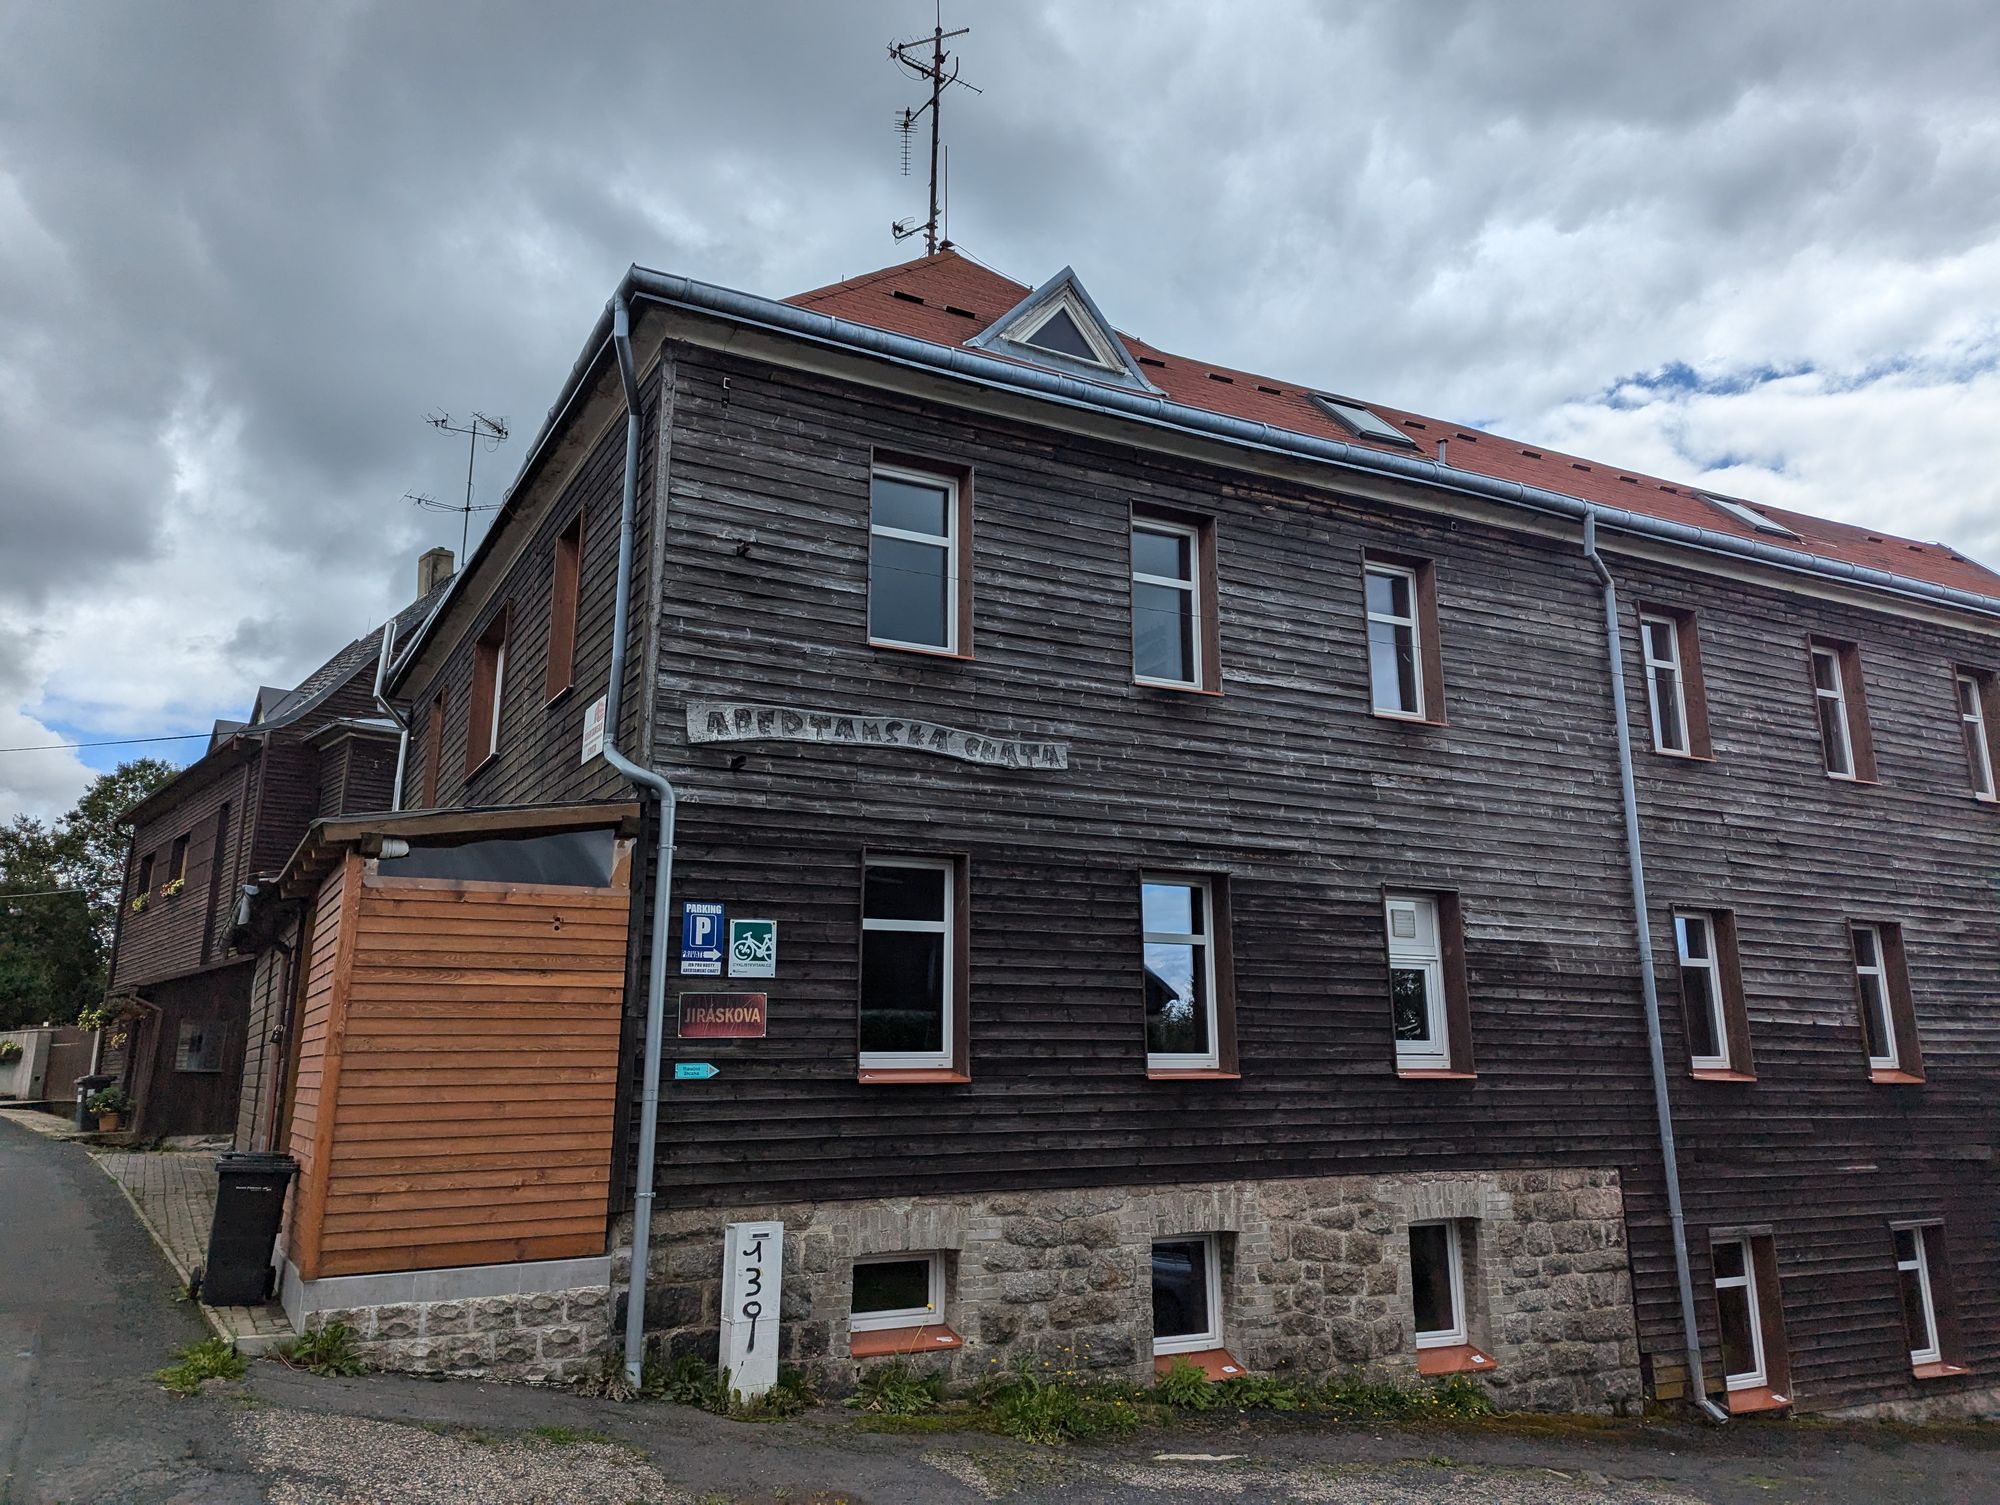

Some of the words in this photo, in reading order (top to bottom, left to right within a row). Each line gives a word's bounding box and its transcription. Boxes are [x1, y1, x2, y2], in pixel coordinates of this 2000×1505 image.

[964, 736, 1064, 768] CHATA
[686, 903, 722, 914] PARKING
[695, 916, 711, 945] P
